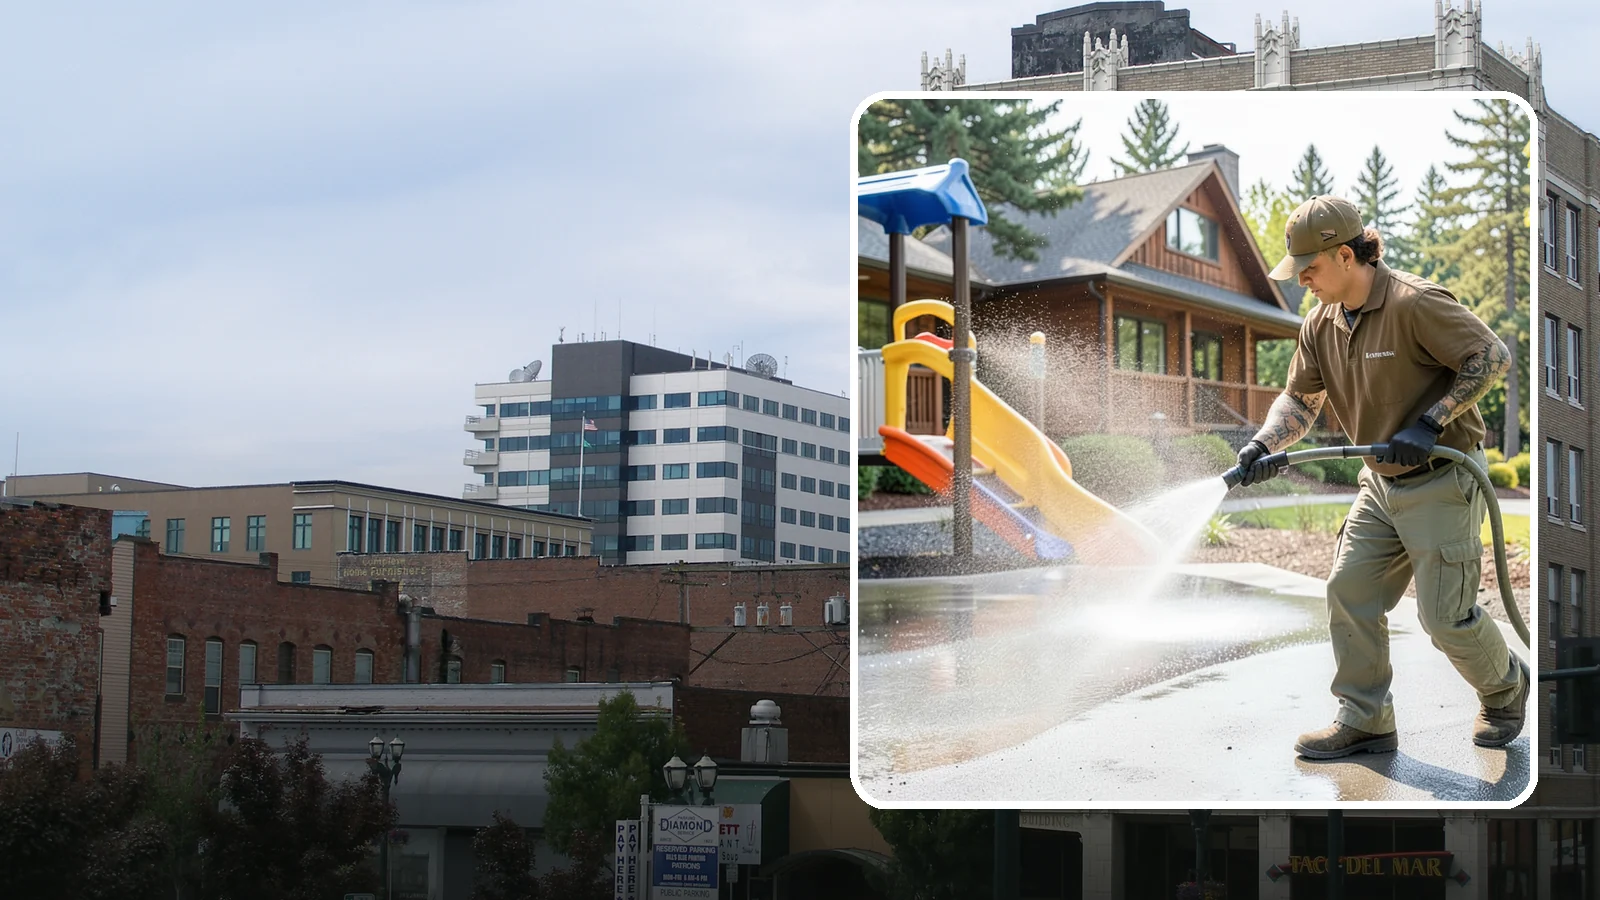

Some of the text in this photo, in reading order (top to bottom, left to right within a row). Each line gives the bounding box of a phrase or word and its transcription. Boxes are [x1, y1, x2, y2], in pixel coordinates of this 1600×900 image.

[343, 565, 427, 577] Home Furnishers
[660, 818, 713, 832] DIAMOND
[1022, 814, 1070, 828] BUILDING
[719, 823, 740, 835] ETT
[656, 845, 716, 854] RESERVED PARKING
[719, 839, 740, 848] ANT
[617, 825, 625, 893] PAY HERE
[628, 824, 637, 893] PAY HERE
[721, 851, 739, 862] Soup
[671, 862, 701, 870] PATRONS
[1288, 855, 1443, 877] TAC DEL MAR
[660, 888, 710, 898] PUBLIC PARKING
